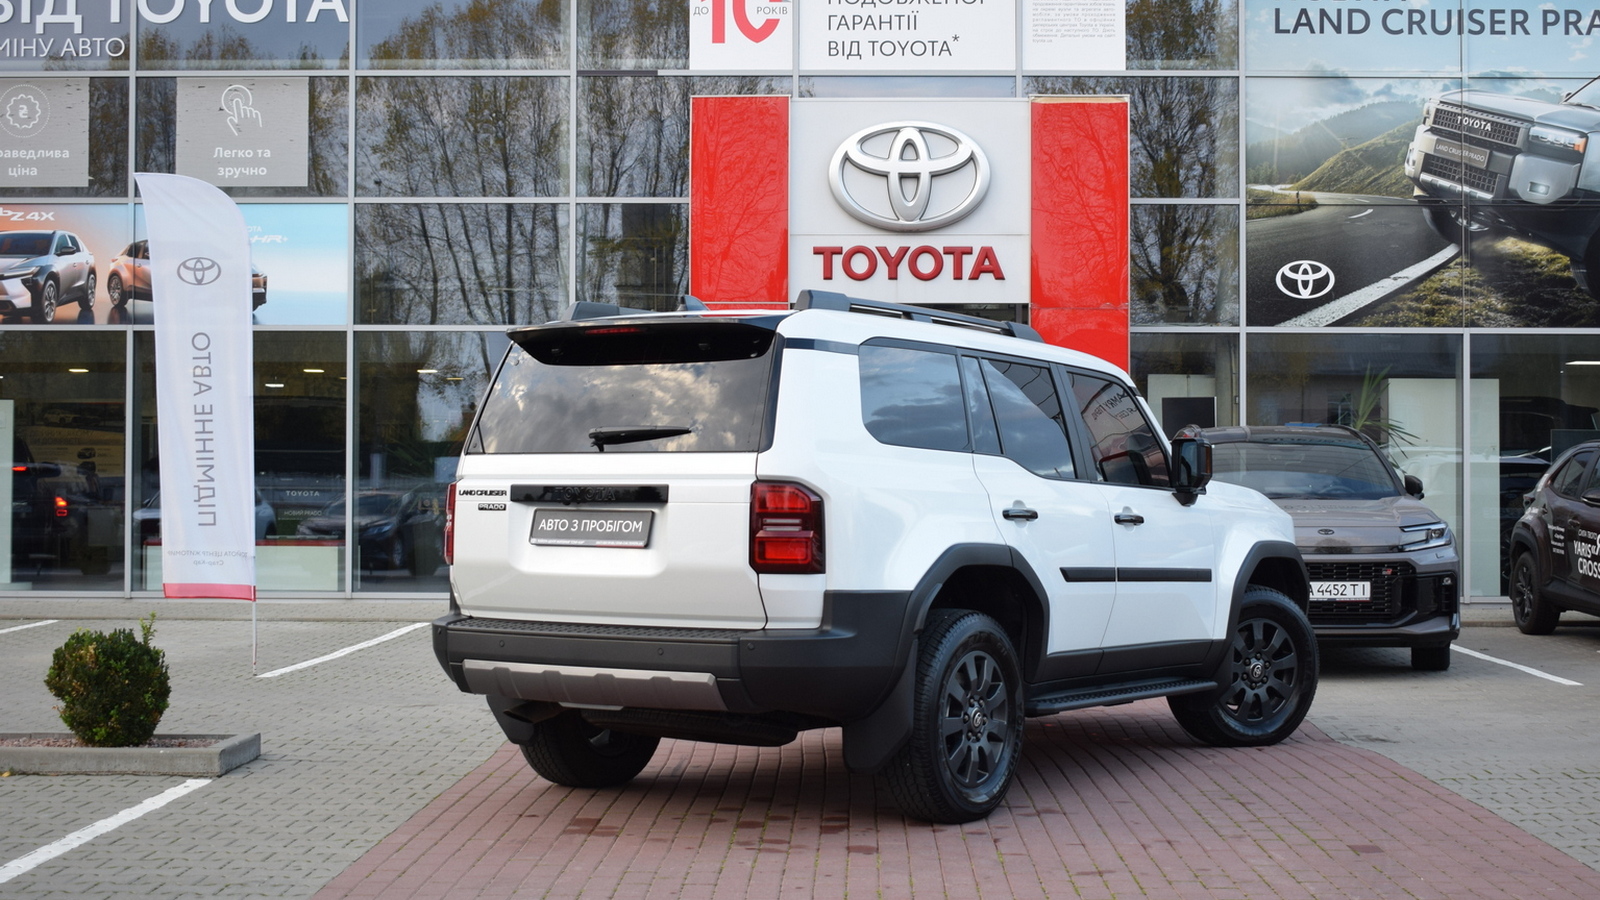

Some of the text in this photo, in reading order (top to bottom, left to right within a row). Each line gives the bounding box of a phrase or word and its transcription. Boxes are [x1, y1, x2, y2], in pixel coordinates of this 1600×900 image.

[693, 6, 710, 16] ДО
[756, 6, 788, 15] РОКІВ
[828, 11, 919, 31] ГАРАНТІЇ
[1274, 8, 1371, 34] LAND
[1381, 8, 1531, 36] CRUISER
[60, 37, 126, 57] АВТО
[828, 41, 862, 60] ВІД
[1457, 116, 1491, 132] TOYOTA
[213, 147, 271, 158] Легко та
[8, 164, 38, 177] ціна
[217, 166, 267, 178] зручно
[812, 245, 1006, 281] TOYOTA
[459, 489, 507, 497] LAND CRUISER
[554, 486, 616, 501] TOYOTA
[538, 518, 644, 533] АВТО З ПРОБІГОМ
[1316, 583, 1348, 596] 4452
